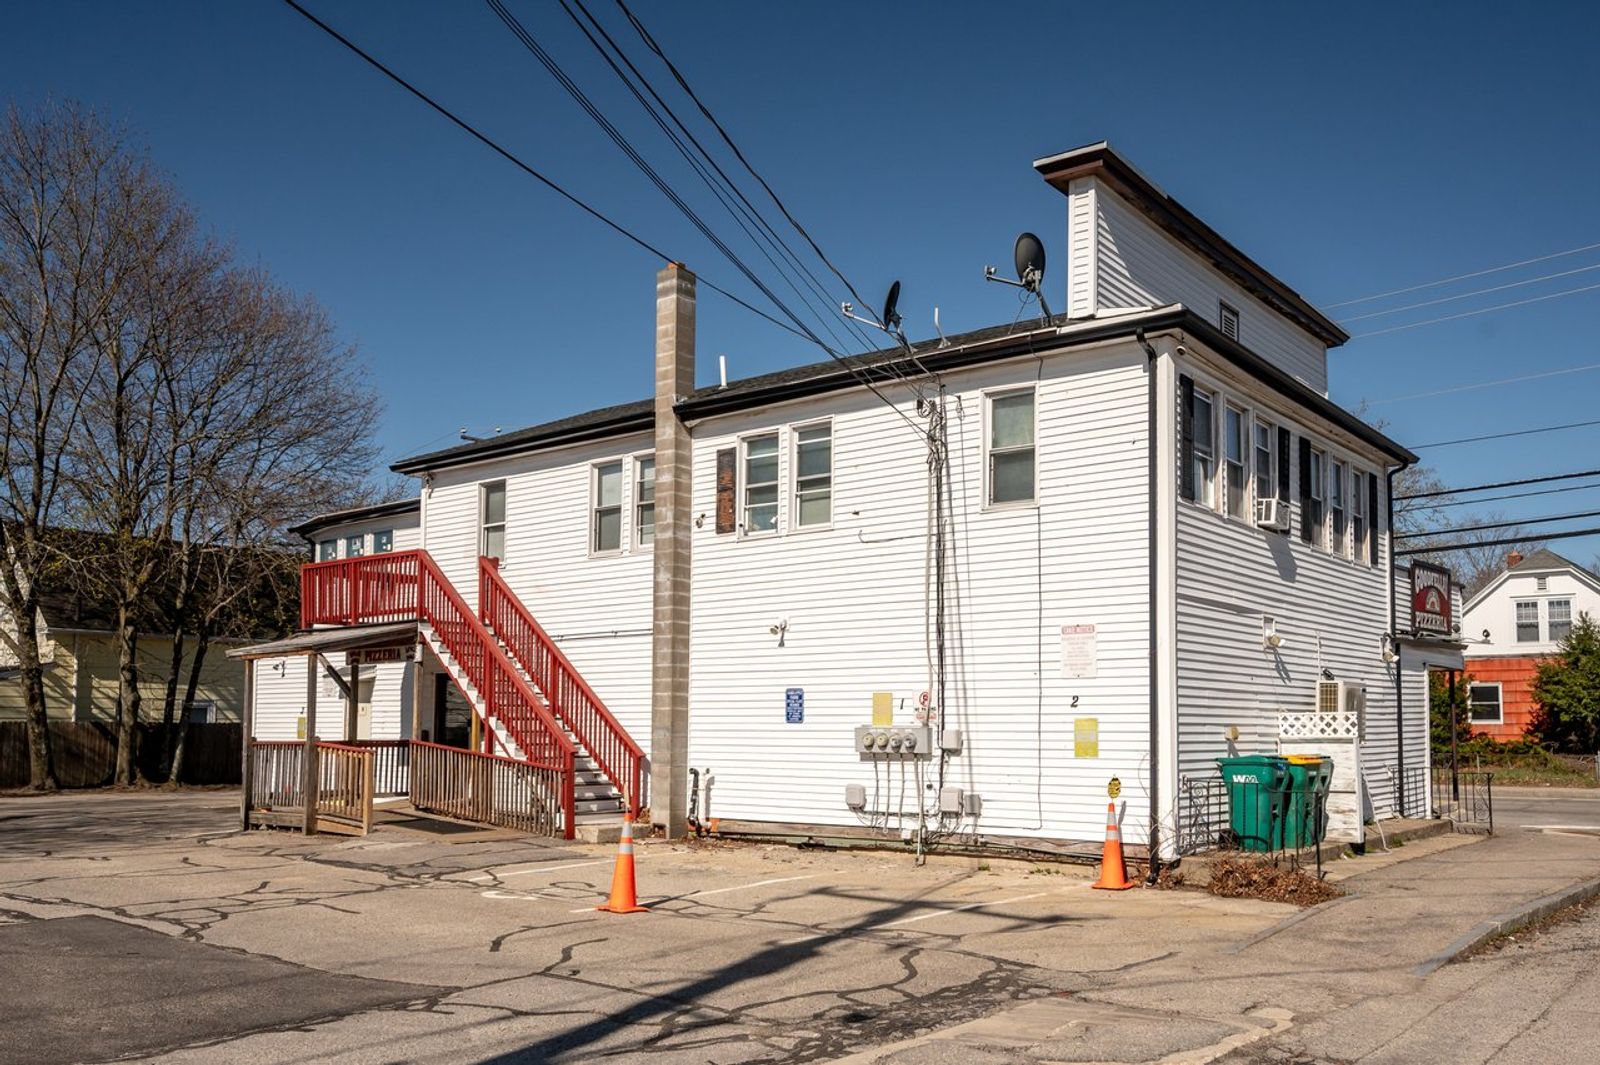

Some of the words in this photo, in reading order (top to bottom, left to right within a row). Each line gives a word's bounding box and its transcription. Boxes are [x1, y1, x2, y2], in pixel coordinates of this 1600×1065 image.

[1415, 611, 1448, 632] PIZZERIA
[365, 648, 400, 663] PIZZERIA
[1070, 695, 1079, 708] 2
